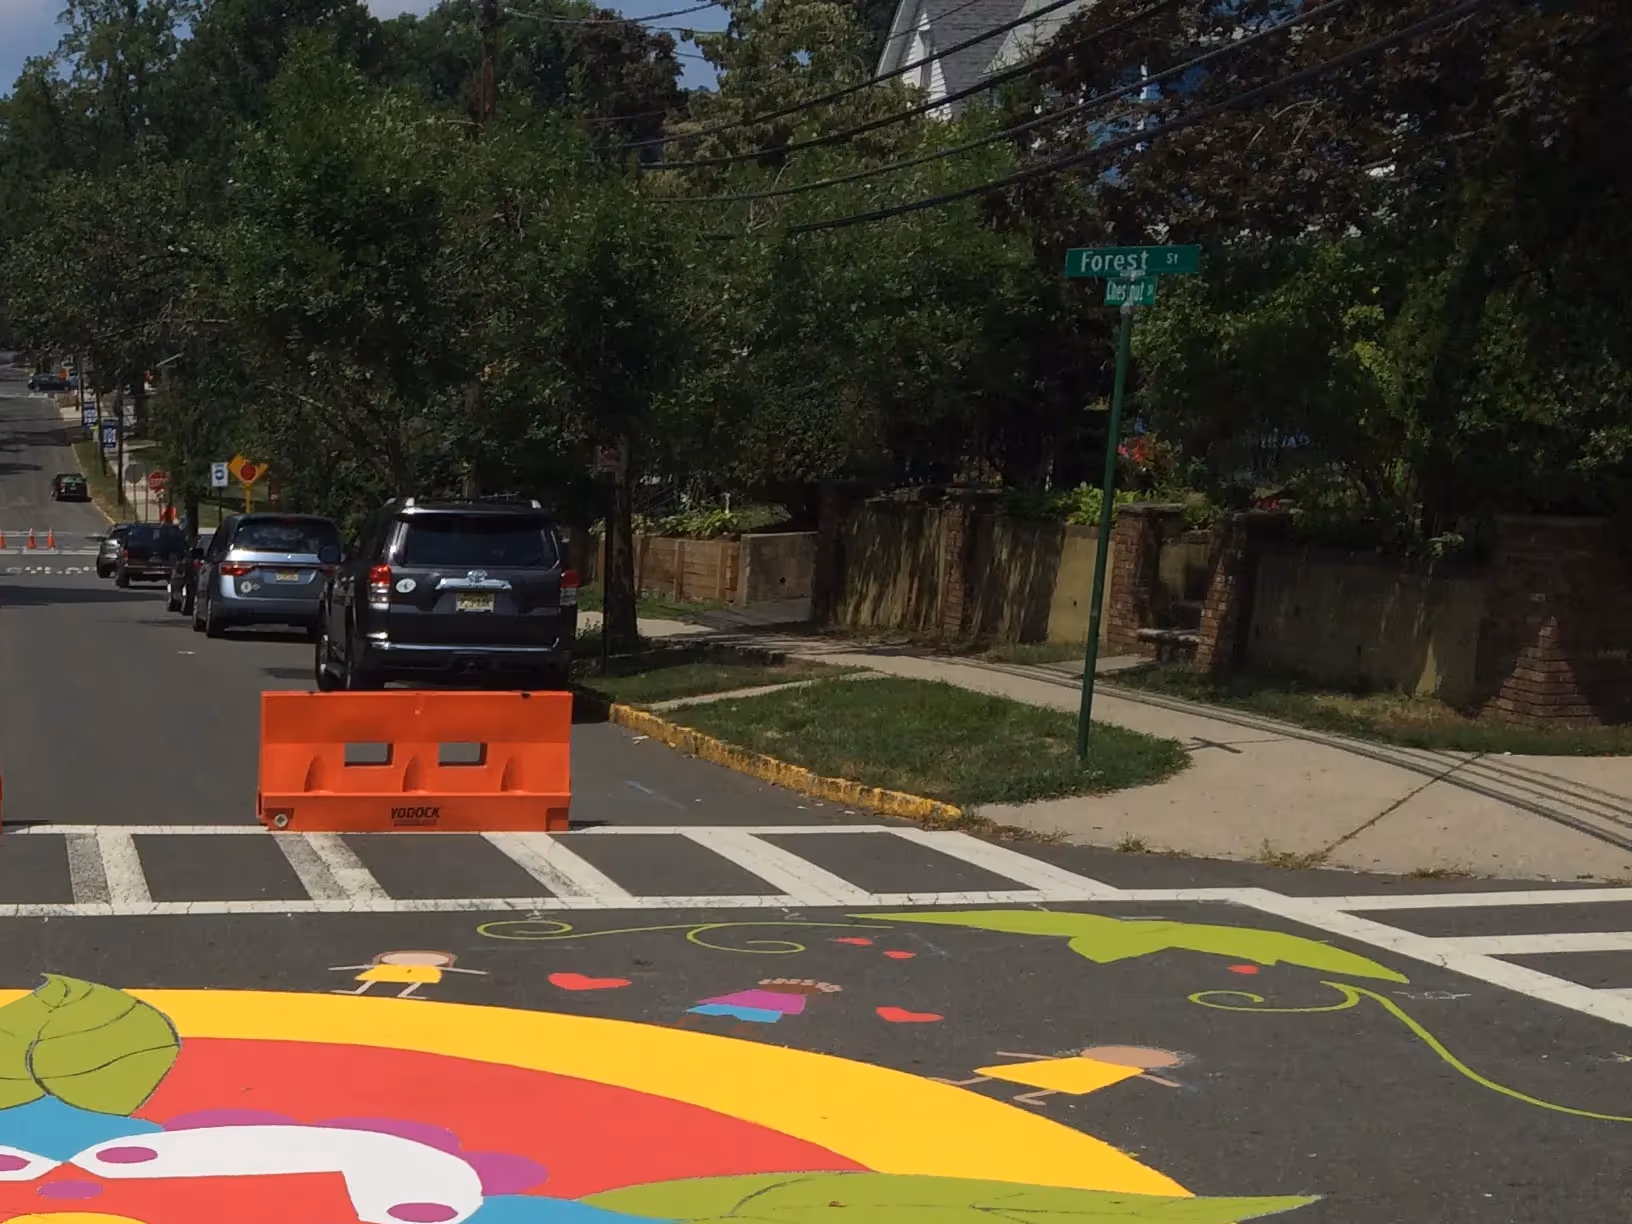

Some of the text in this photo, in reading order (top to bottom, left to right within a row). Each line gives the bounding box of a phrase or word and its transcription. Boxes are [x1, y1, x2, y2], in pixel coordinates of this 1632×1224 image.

[1080, 249, 1179, 273] Forest St
[1105, 279, 1145, 301] Chesnut
[391, 807, 440, 819] YODOCK
